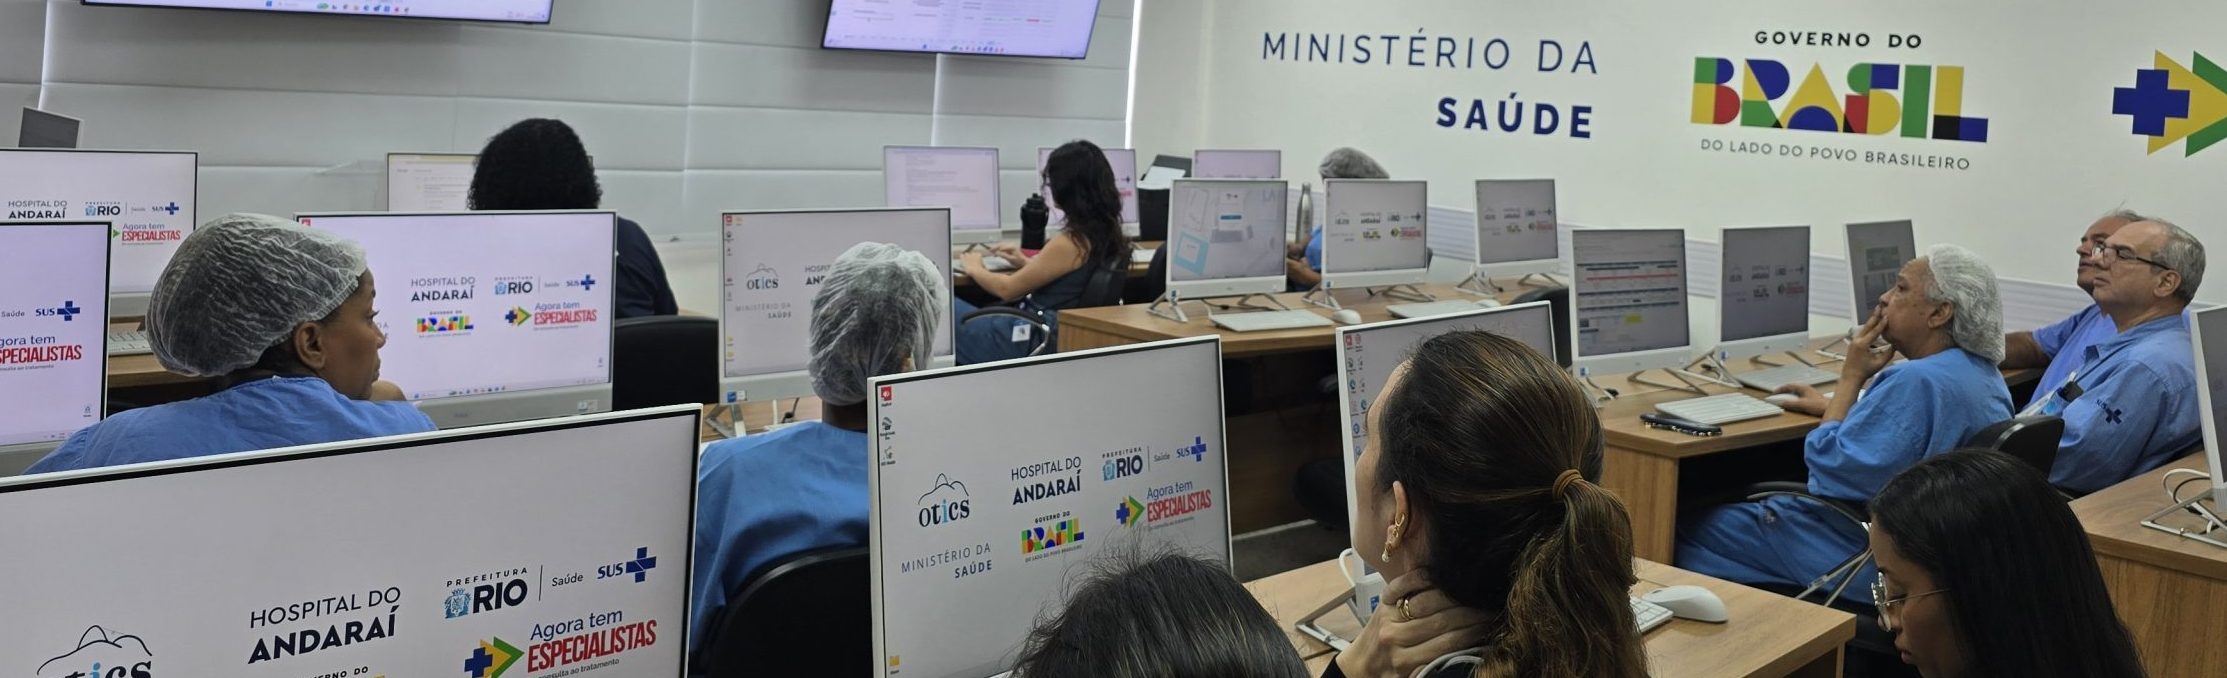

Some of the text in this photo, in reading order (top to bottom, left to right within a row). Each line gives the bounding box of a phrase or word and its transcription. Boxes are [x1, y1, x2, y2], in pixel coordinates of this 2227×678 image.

[1755, 31, 1922, 48] GOVERNO DO
[1262, 27, 1598, 74] MINISTÉRIO DA
[1690, 57, 1988, 143] BRASIL
[1436, 92, 1592, 139] SAÚDE
[1701, 139, 1970, 171] DO LADO DO POVO BRASILEIRO
[8, 207, 66, 219] ANDARAÍ
[97, 205, 121, 216] RIO
[121, 230, 181, 241] ESPECIALISTAS
[411, 276, 475, 287] HOSPITAL DO
[507, 281, 533, 294] RIO
[411, 285, 474, 302] ANDARAÍ
[1, 310, 25, 318] Saúde
[35, 308, 55, 317] SUS
[535, 301, 581, 311] Agora tem
[533, 309, 598, 325] ESPECIALISTAS
[0, 335, 56, 348] gora tem
[0, 344, 82, 365] PECIALISTAS
[1176, 446, 1191, 459] SUS
[1011, 456, 1082, 481] HOSPITAL DO
[1116, 454, 1143, 478] RIO
[1012, 469, 1082, 505] ANDARAÍ
[1146, 481, 1193, 501] Agora tem
[918, 498, 970, 527] otics
[1147, 489, 1212, 522] ESPECIALISTAS
[1021, 518, 1084, 555] BRASIL
[901, 542, 991, 574] MINISTÉRIO DA
[446, 567, 528, 587] PREFEITURA
[597, 562, 624, 580] SUS
[954, 559, 992, 579] SAÚDE
[551, 572, 584, 587] Saúde
[472, 578, 528, 614] RIO
[250, 586, 401, 629] HOSPITAL DO
[247, 604, 400, 665] ANDARAÍ
[530, 610, 623, 641] Agora tem
[527, 619, 658, 673] ESPECIALISTAS
[354, 666, 369, 675] DO
[580, 658, 620, 673] tratamento
